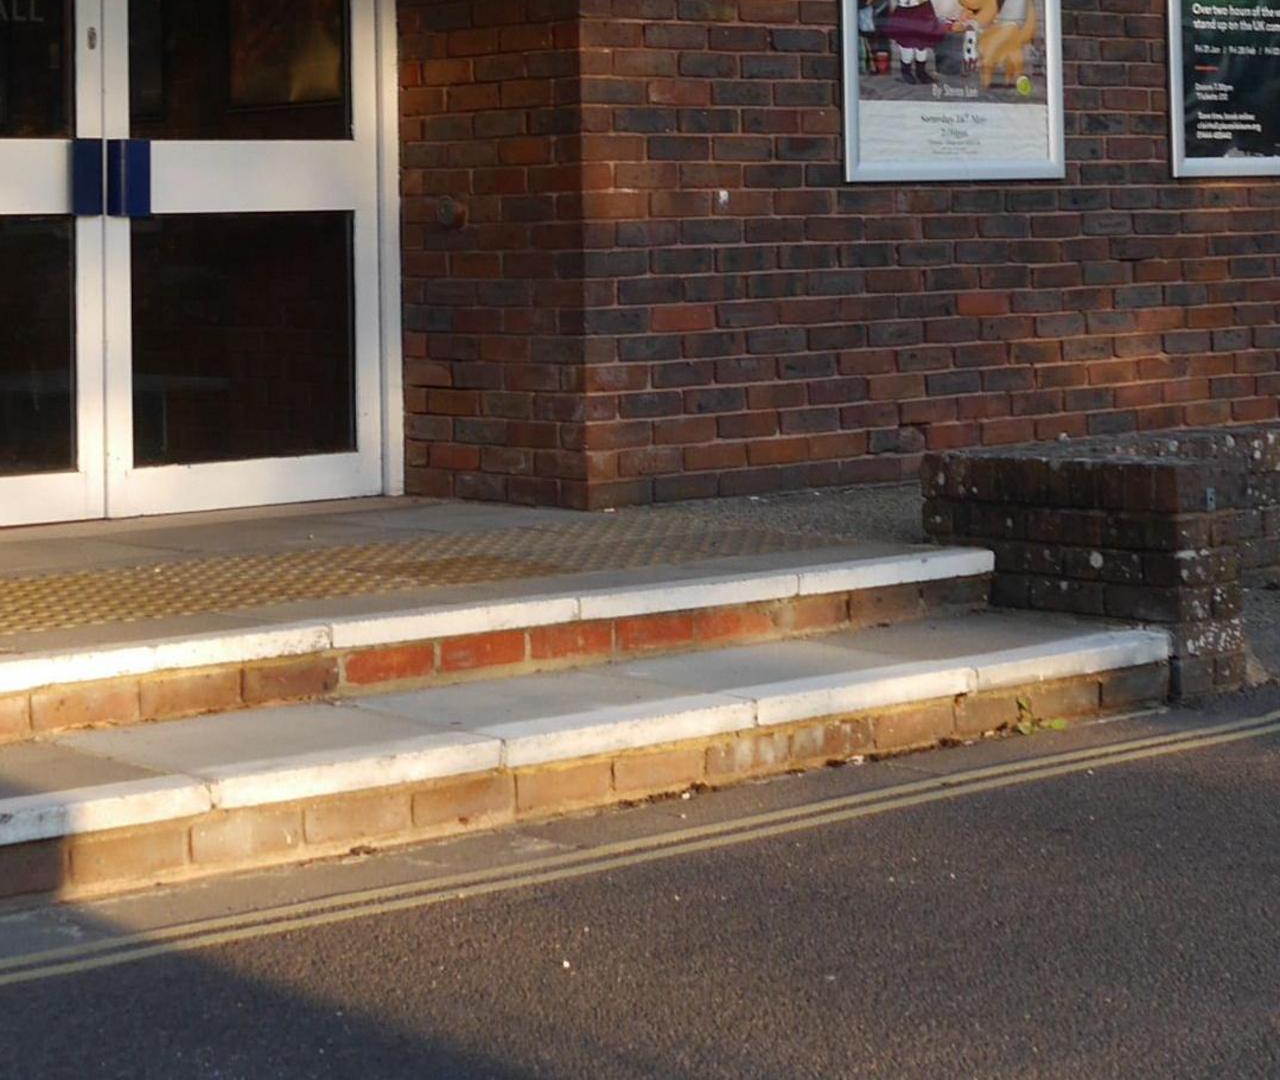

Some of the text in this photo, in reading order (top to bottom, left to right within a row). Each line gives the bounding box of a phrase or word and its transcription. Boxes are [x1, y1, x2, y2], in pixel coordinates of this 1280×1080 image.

[1191, 2, 1212, 16] Over
[1228, 5, 1250, 17] hours
[1251, 5, 1261, 17] of
[1261, 5, 1274, 18] the
[1192, 18, 1217, 30] stand
[1217, 21, 1228, 33] up
[1239, 20, 1253, 32] the
[1253, 20, 1266, 32] UK
